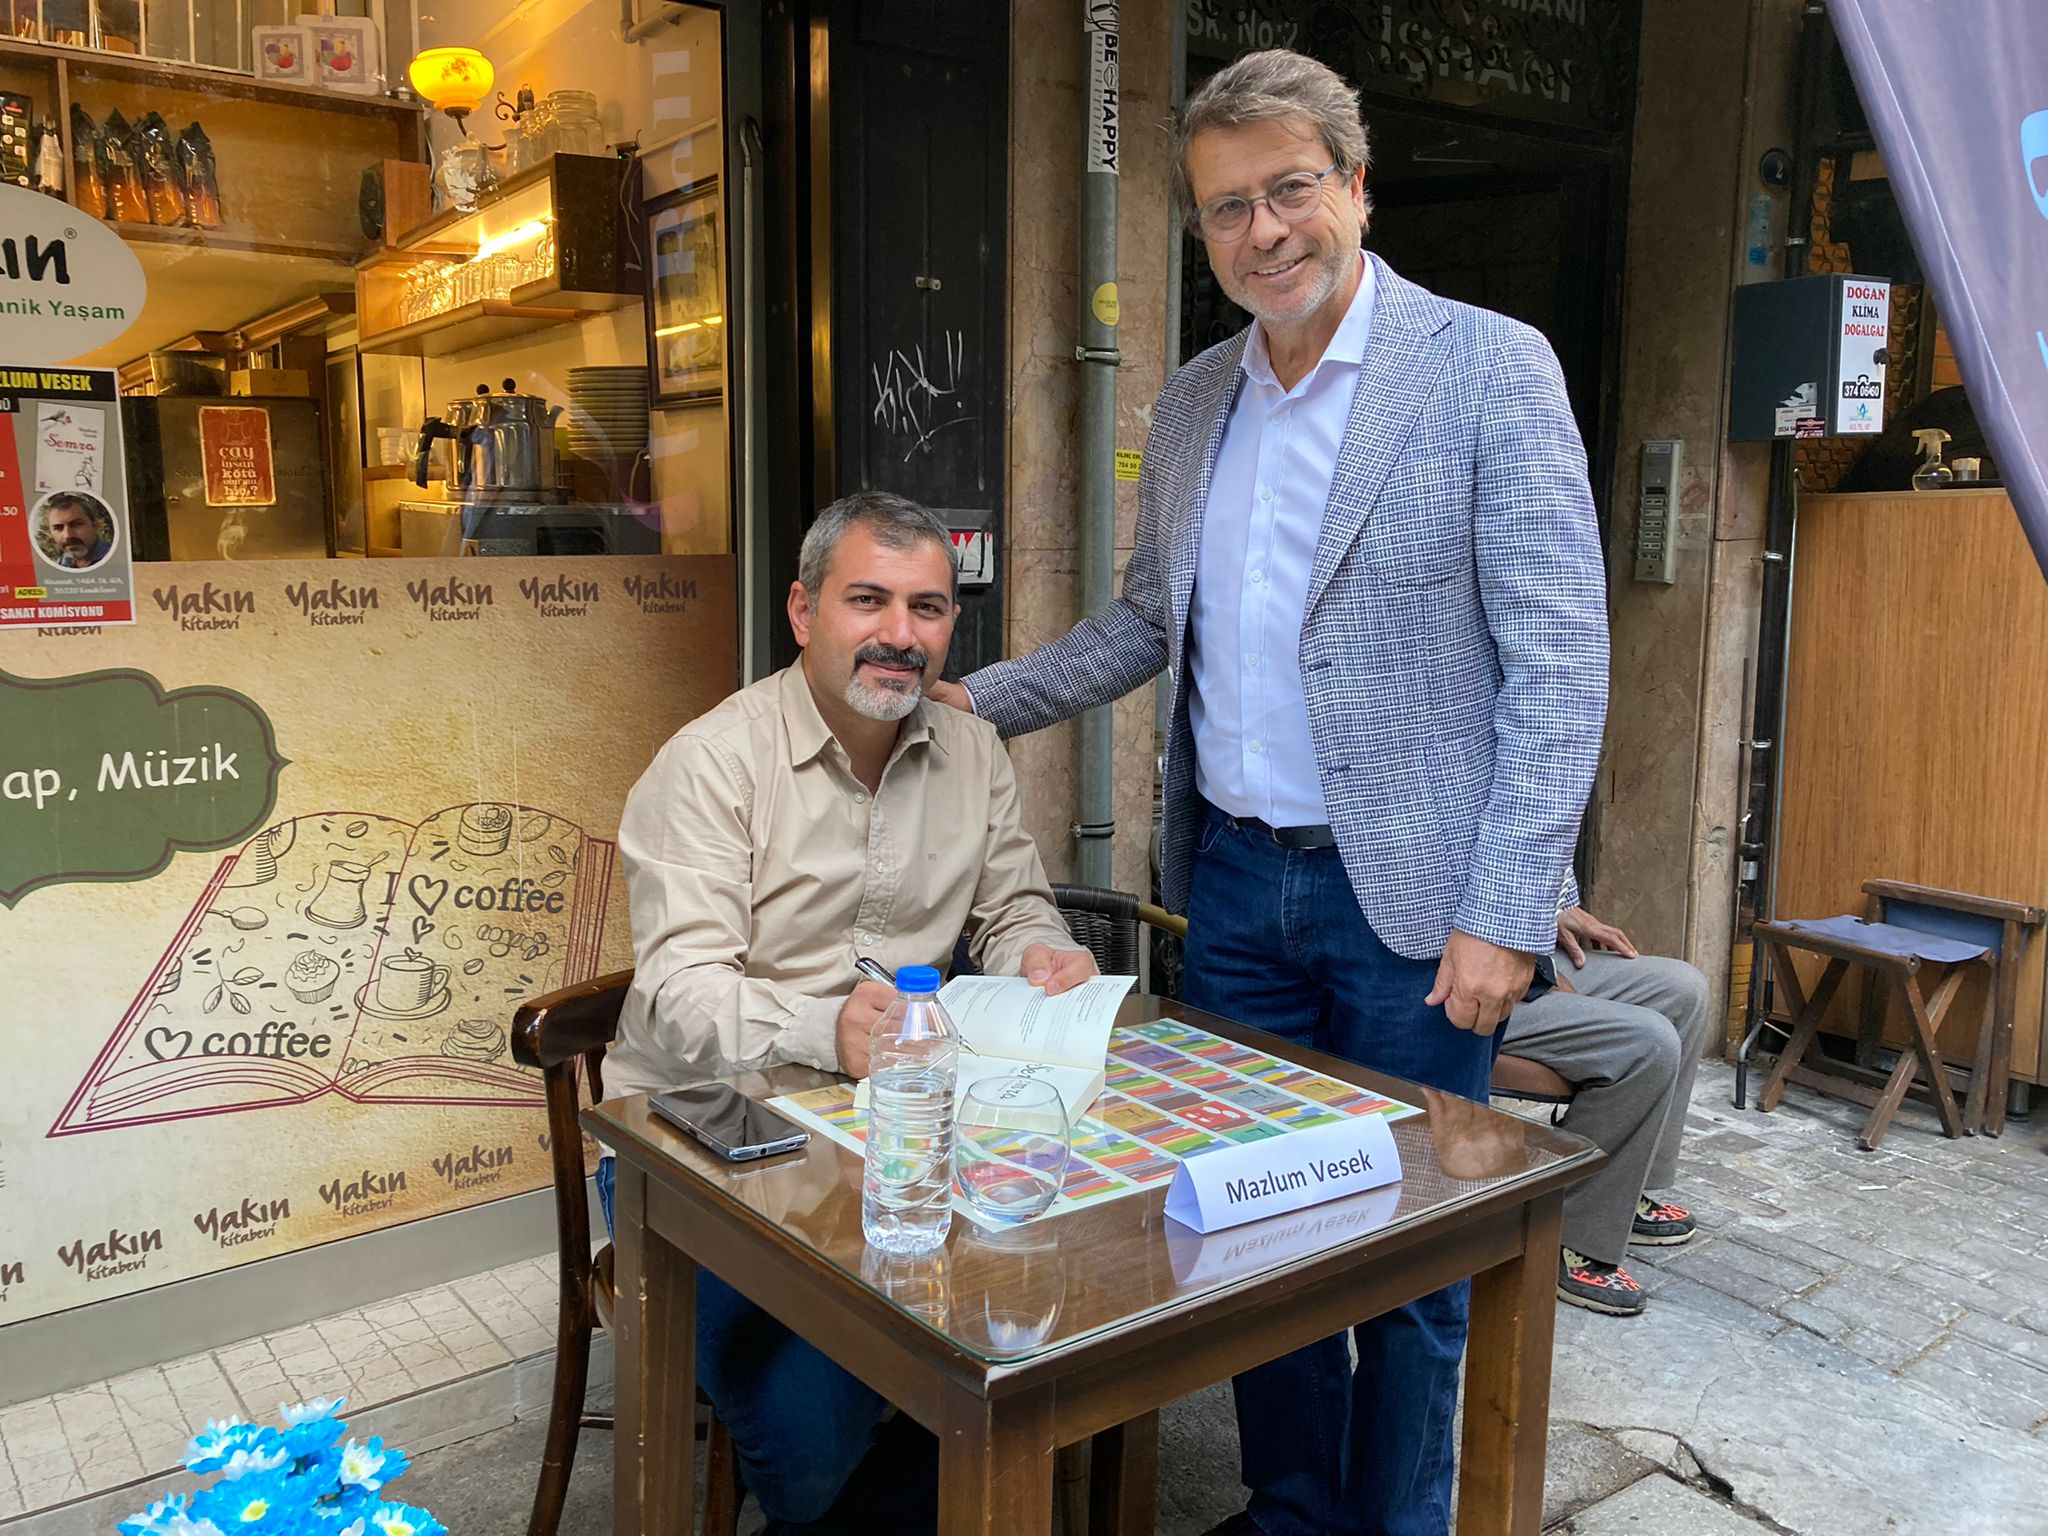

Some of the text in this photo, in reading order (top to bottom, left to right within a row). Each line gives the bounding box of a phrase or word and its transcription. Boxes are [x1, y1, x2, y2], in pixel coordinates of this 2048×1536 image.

[1102, 34, 1118, 171] BE HAPPY
[0, 235, 70, 284] ın
[1847, 284, 1886, 301] DOĞAN
[49, 301, 125, 321] Yaşam
[1852, 304, 1880, 318] KLİMA
[1844, 321, 1886, 337] DOĞALGAZ
[0, 371, 93, 392] LUM VESEK
[1844, 384, 1859, 397] 374
[219, 446, 255, 460] çay
[221, 460, 255, 468] insan
[221, 468, 257, 479] kötü
[0, 605, 104, 620] SANAT KOMİSYONU
[97, 742, 240, 791] Müzik
[379, 871, 564, 914] I coffee
[202, 1021, 331, 1058] coffee
[1224, 1149, 1374, 1205] Mazlum Vesek
